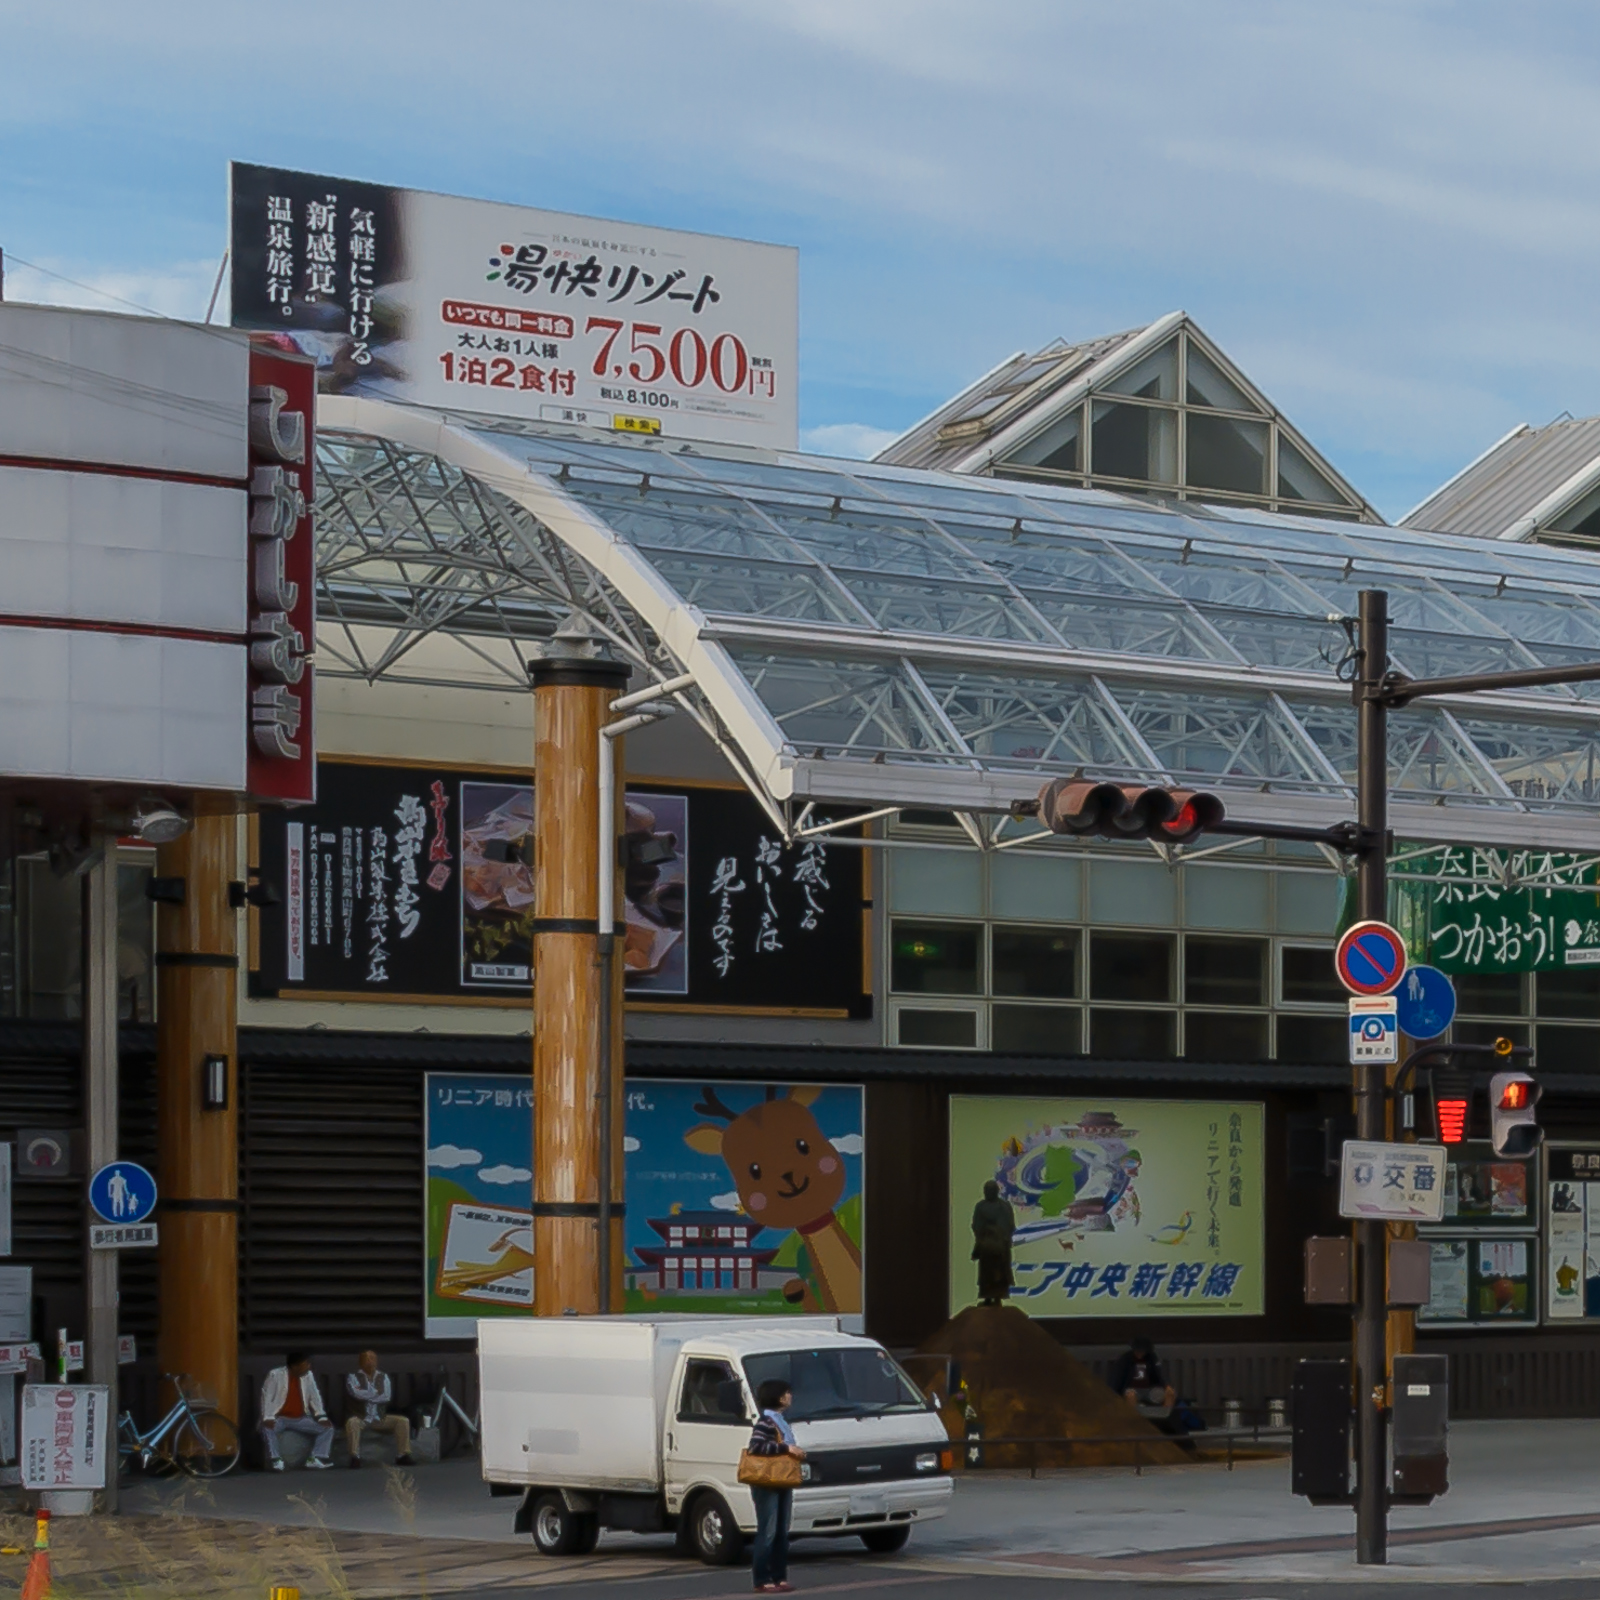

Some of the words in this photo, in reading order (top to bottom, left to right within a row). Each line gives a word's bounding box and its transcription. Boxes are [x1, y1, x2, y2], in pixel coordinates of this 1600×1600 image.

[266, 195, 293, 316] 温泉旅行。
[350, 207, 376, 366] 気軽に行ける
[486, 244, 720, 314] 湯快リゾート
[446, 304, 571, 336] いつでも同一料金
[458, 332, 559, 360] 大人お1人様
[439, 351, 577, 397] 1泊2食付
[251, 385, 306, 759] ひがしむき
[1381, 1163, 1437, 1191] 交番
[1009, 1261, 1244, 1299] ニア中央新幹線
